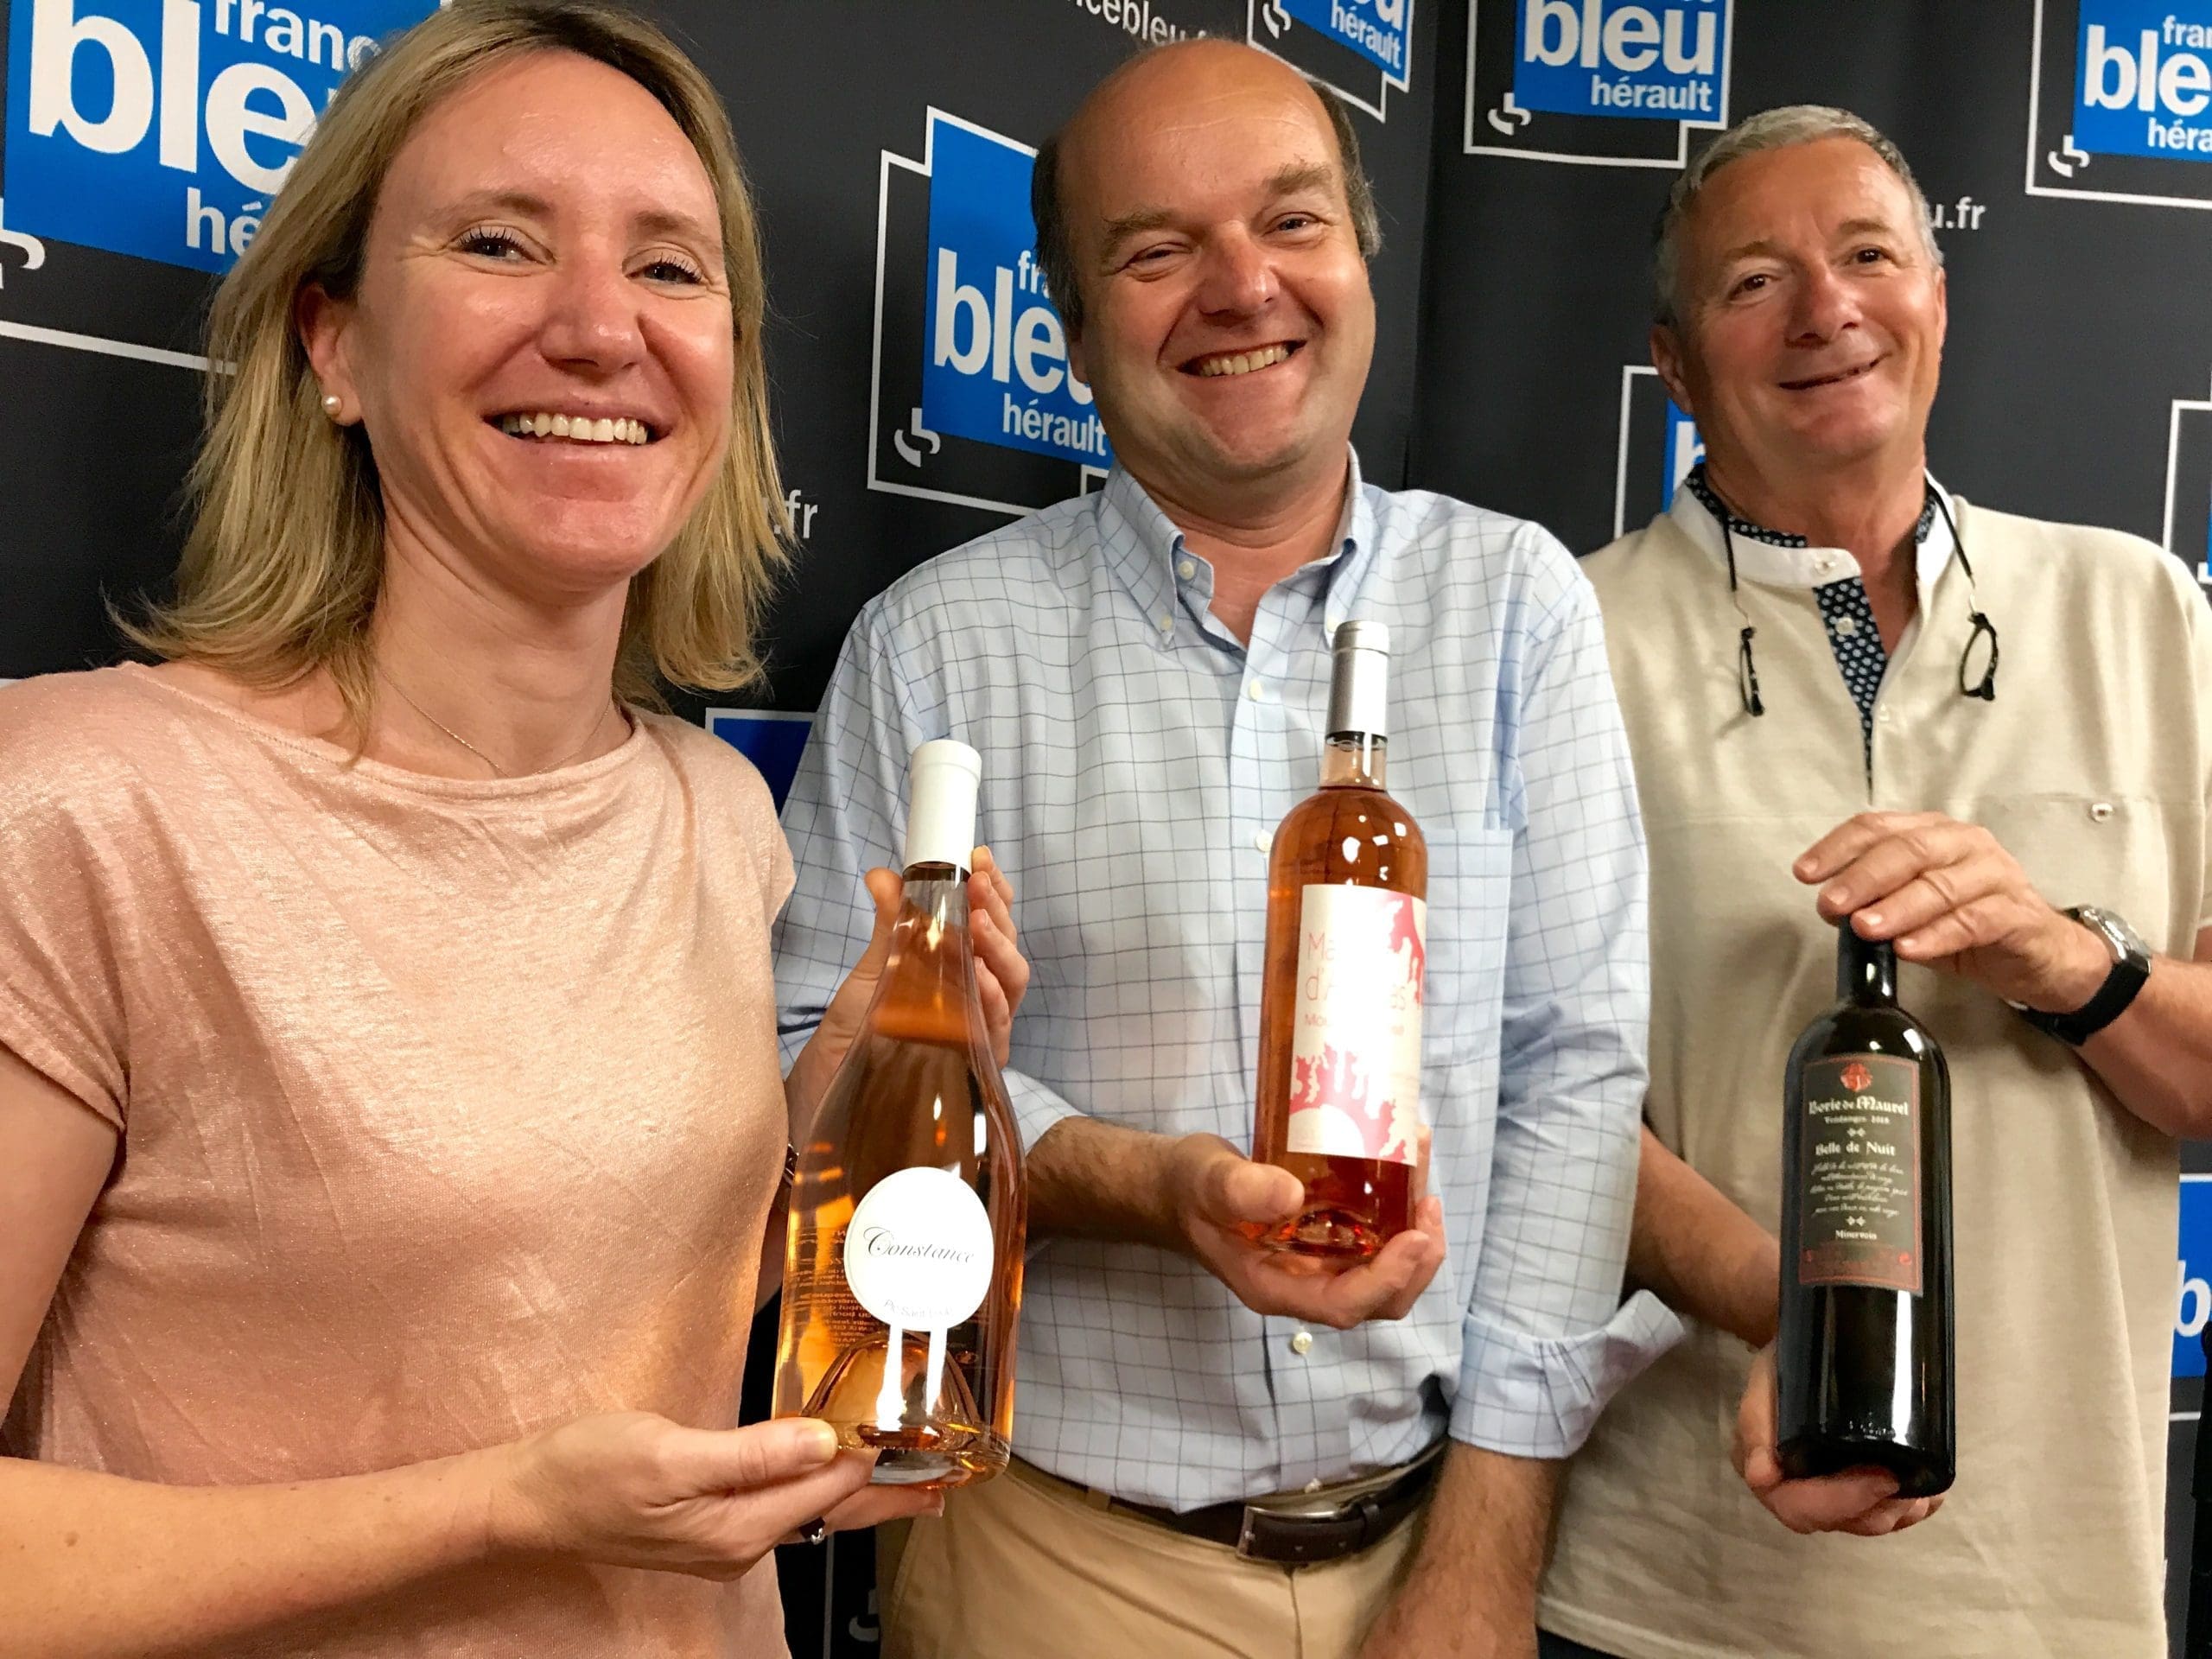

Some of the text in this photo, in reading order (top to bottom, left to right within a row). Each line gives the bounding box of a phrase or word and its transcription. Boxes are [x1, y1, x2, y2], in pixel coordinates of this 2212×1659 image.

[214, 0, 383, 72] franc
[1331, 0, 1402, 69] hérault
[1523, 0, 1717, 75] bleu
[29, 0, 321, 195] ble
[1591, 75, 1713, 112] hérault
[2084, 24, 2212, 116] ble
[2147, 117, 2212, 152] héra
[1002, 393, 1107, 456] hérault
[1856, 1095, 1909, 1116] Maurel
[1815, 1141, 1895, 1156] Belle de Nuit
[863, 1226, 975, 1263] Constance
